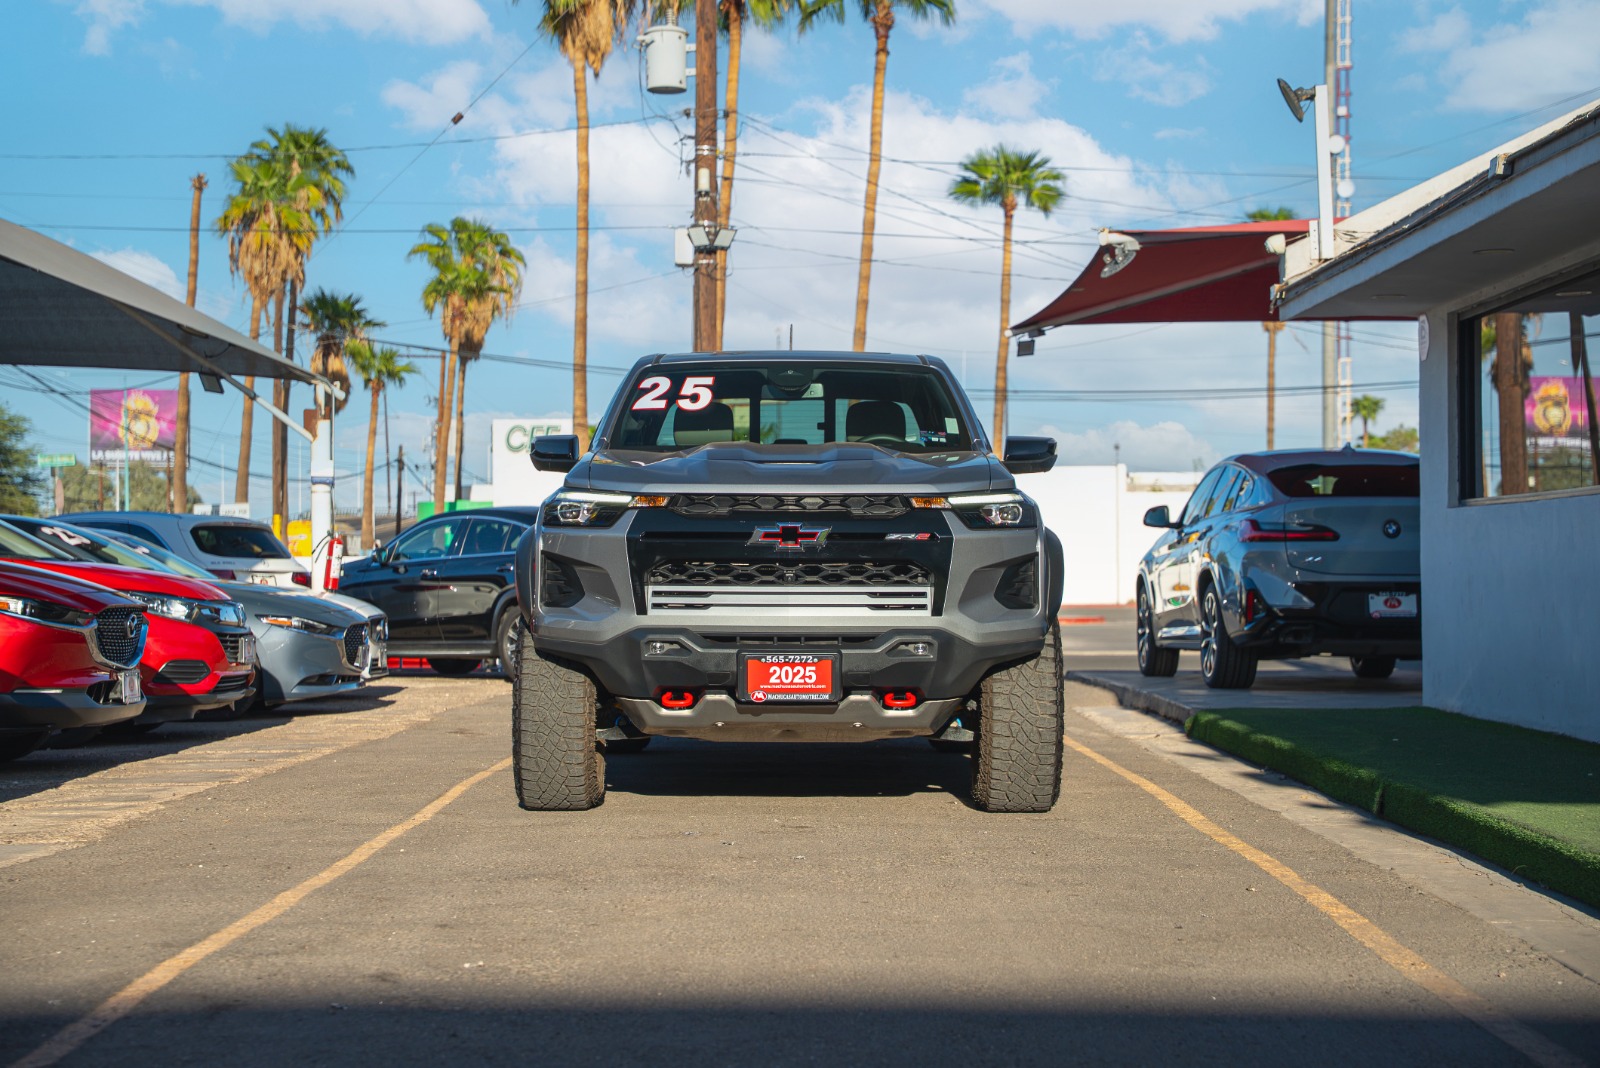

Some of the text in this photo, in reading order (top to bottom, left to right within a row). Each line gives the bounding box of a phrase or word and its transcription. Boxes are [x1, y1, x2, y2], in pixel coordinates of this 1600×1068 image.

[632, 376, 715, 411] 25
[766, 655, 813, 663] 565-7272
[769, 666, 817, 684] 2025
